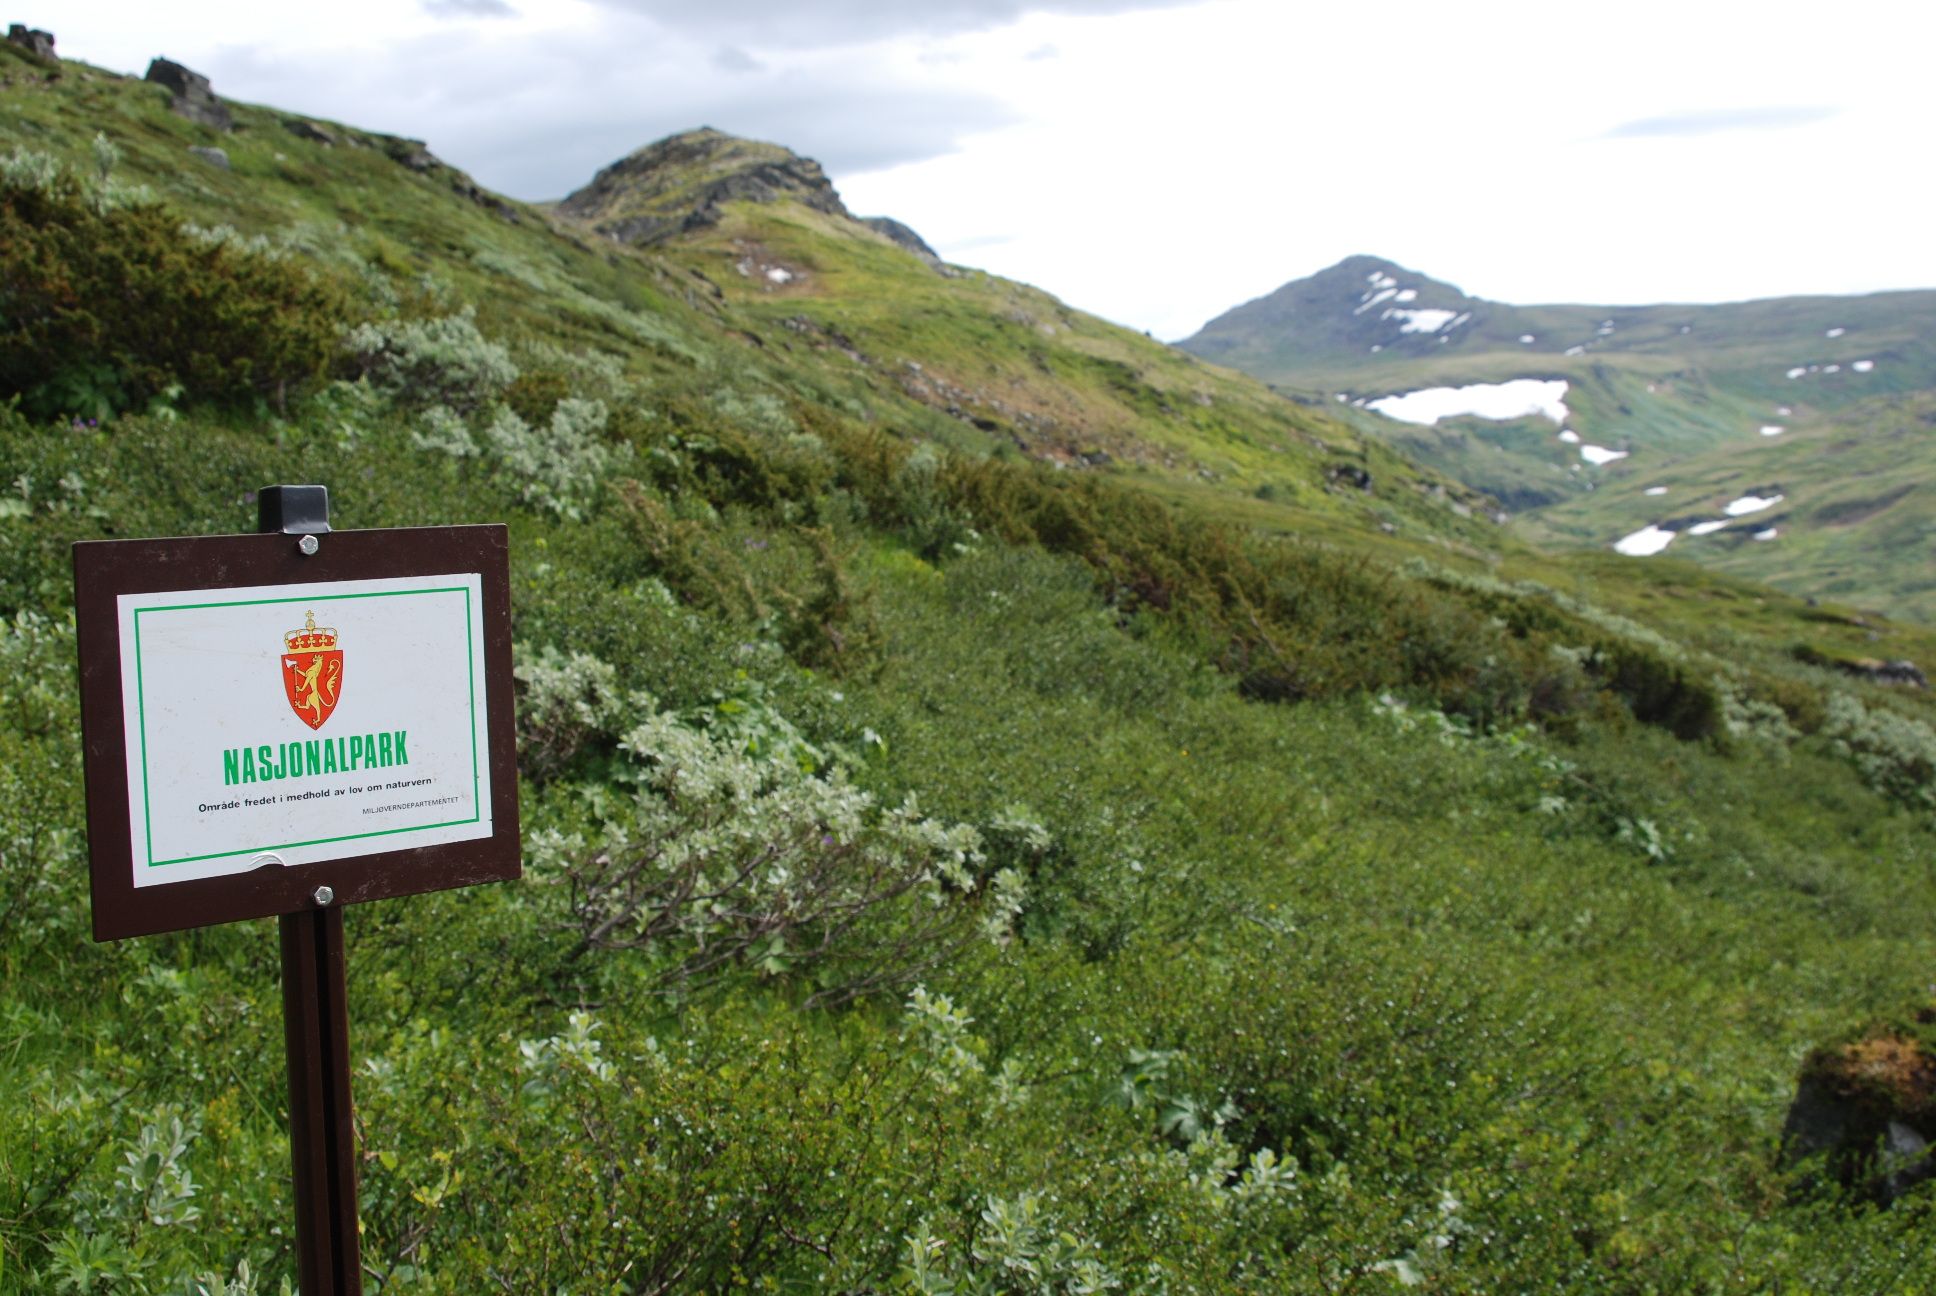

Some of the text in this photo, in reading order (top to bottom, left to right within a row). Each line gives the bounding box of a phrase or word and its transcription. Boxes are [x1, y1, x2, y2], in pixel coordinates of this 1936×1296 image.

[223, 730, 409, 786] NASJONALPARK
[198, 778, 432, 813] Område fredet i medhold av lov om naturvern
[362, 796, 459, 815] MILJØVERNDEPARTEMENTET
